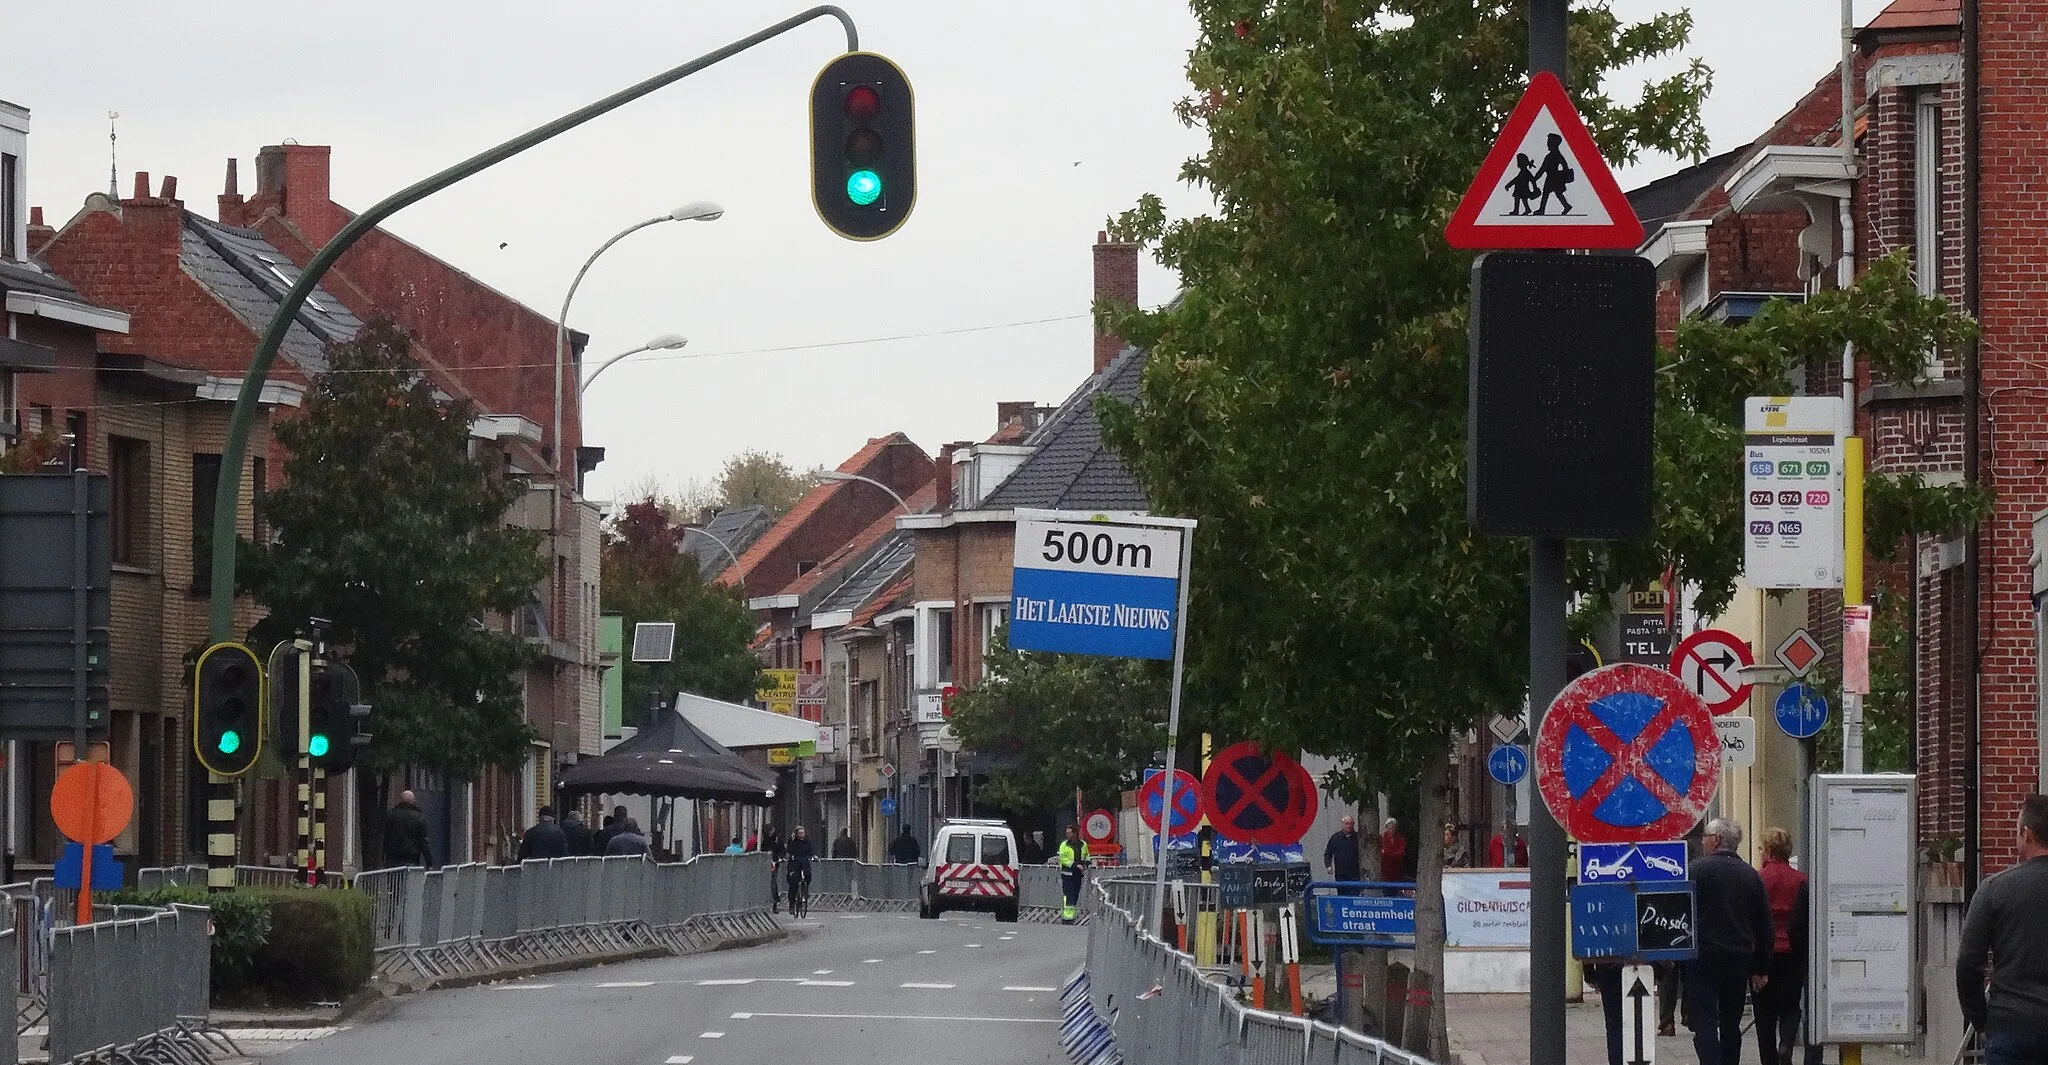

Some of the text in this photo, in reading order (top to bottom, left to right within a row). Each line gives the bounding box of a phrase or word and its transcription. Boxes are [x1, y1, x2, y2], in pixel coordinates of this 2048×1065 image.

[1749, 450, 1764, 458] Bus
[1752, 464, 1827, 474] 658 671 671
[1751, 493, 1828, 503] 674 674 720
[1752, 523, 1801, 533] 776 N65
[1042, 530, 1152, 569] 500m
[1015, 596, 1171, 631] HET LAATSTE NIEUWS
[1626, 642, 1660, 655] TEL
[1342, 920, 1376, 931] straat
